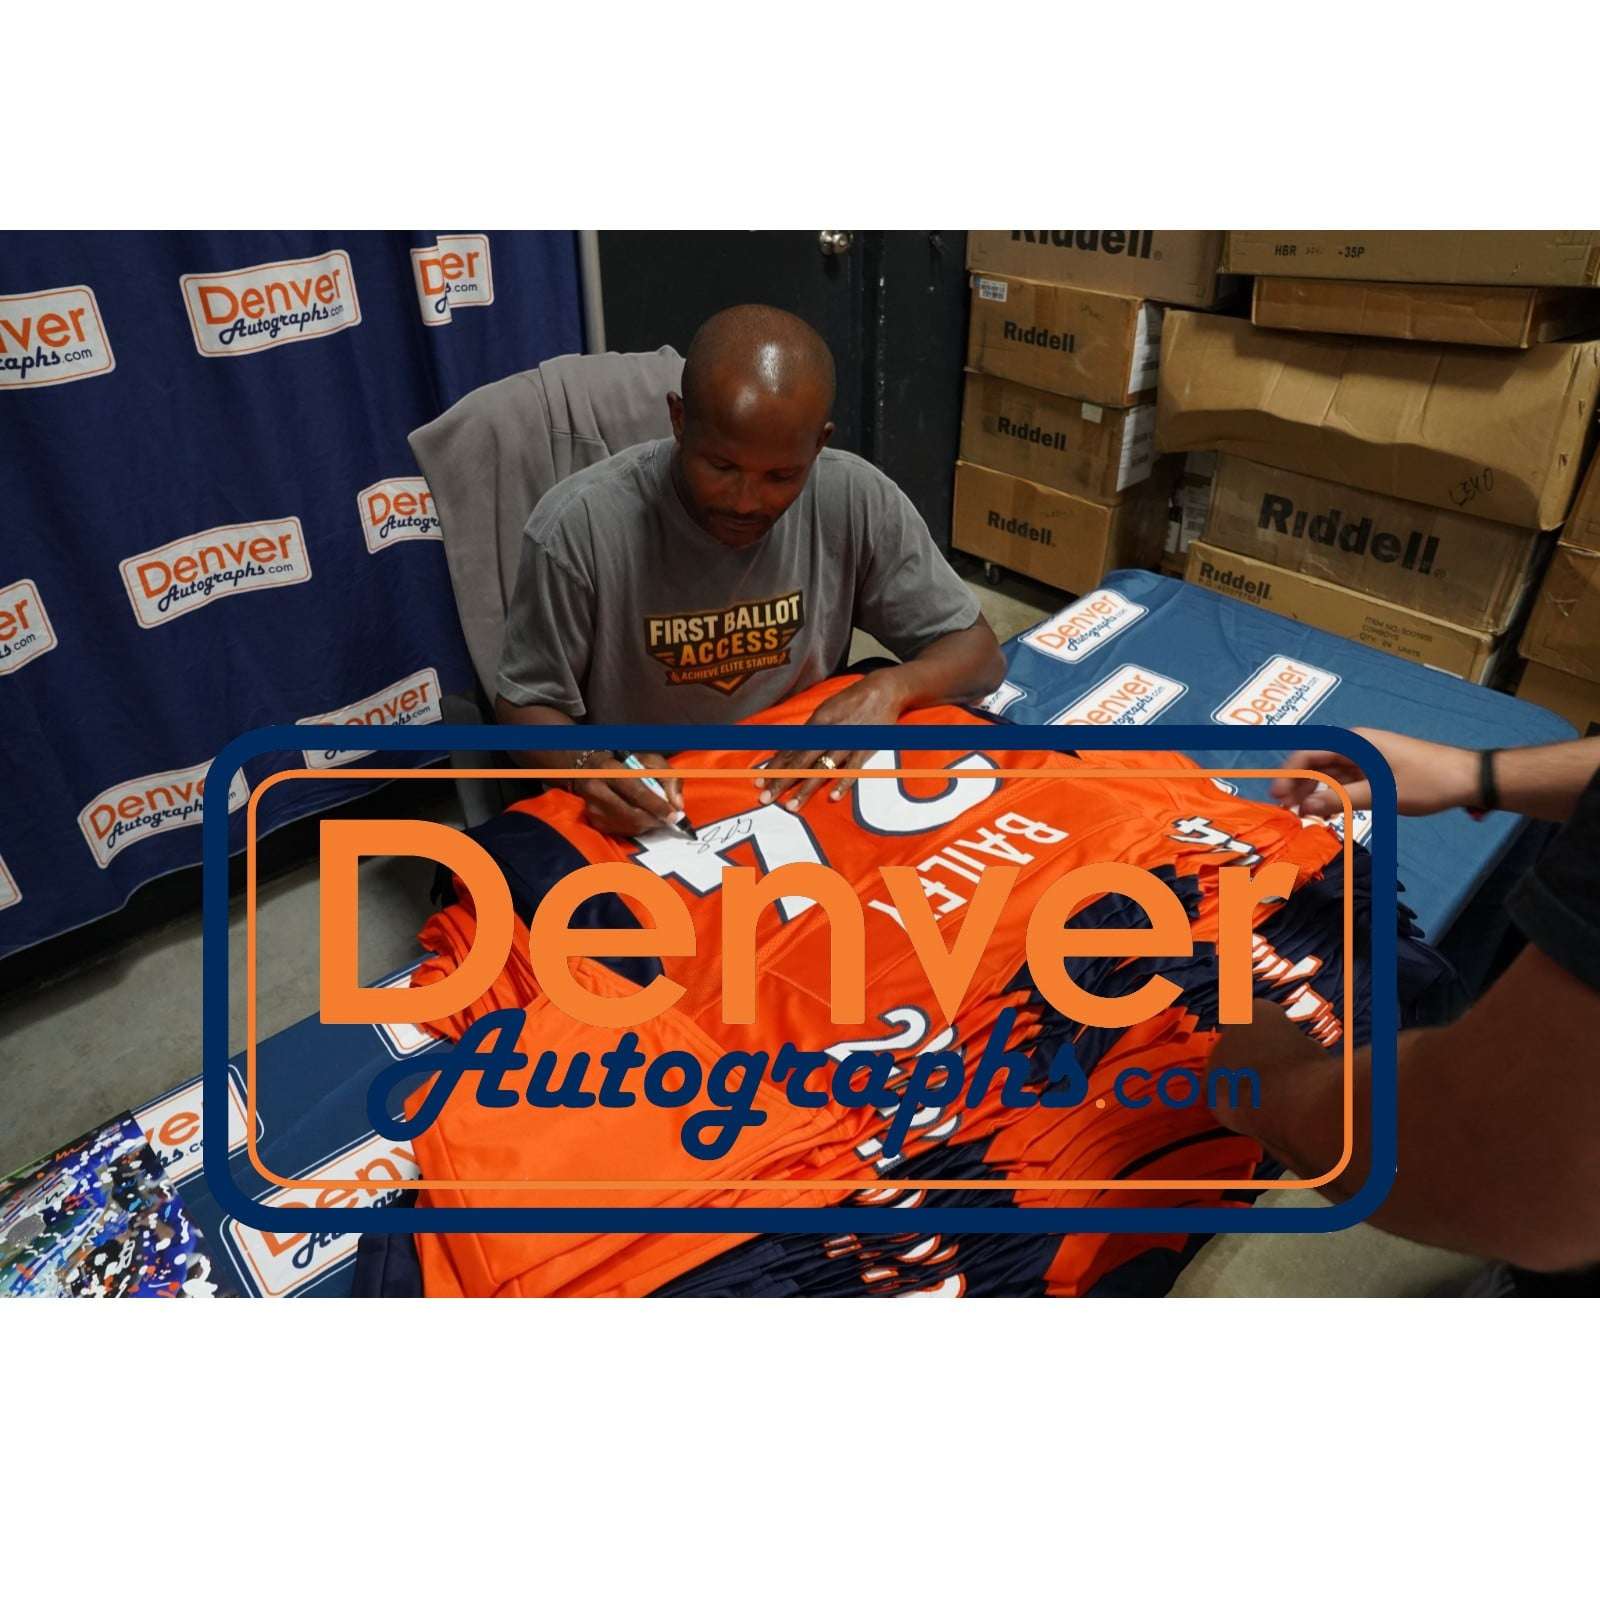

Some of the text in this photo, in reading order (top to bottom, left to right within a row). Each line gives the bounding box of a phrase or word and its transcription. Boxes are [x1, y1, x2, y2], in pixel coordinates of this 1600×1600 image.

[198, 269, 341, 325] Denver
[0, 307, 86, 353] ver
[1003, 320, 1075, 353] Riddell
[997, 416, 1067, 451] Riddell
[986, 510, 1052, 546] Riddell
[1257, 493, 1441, 575] Riddell
[137, 533, 291, 599] Denver
[1200, 562, 1272, 600] Riddell
[650, 594, 800, 647] FIRST BALLOT
[1036, 595, 1120, 649] Denver
[680, 628, 779, 667] ACCESS
[720, 660, 744, 675] ELITE
[746, 653, 779, 668] STATUS
[1064, 672, 1154, 725] enver
[1230, 665, 1307, 725] Denver
[90, 778, 204, 840] Denv
